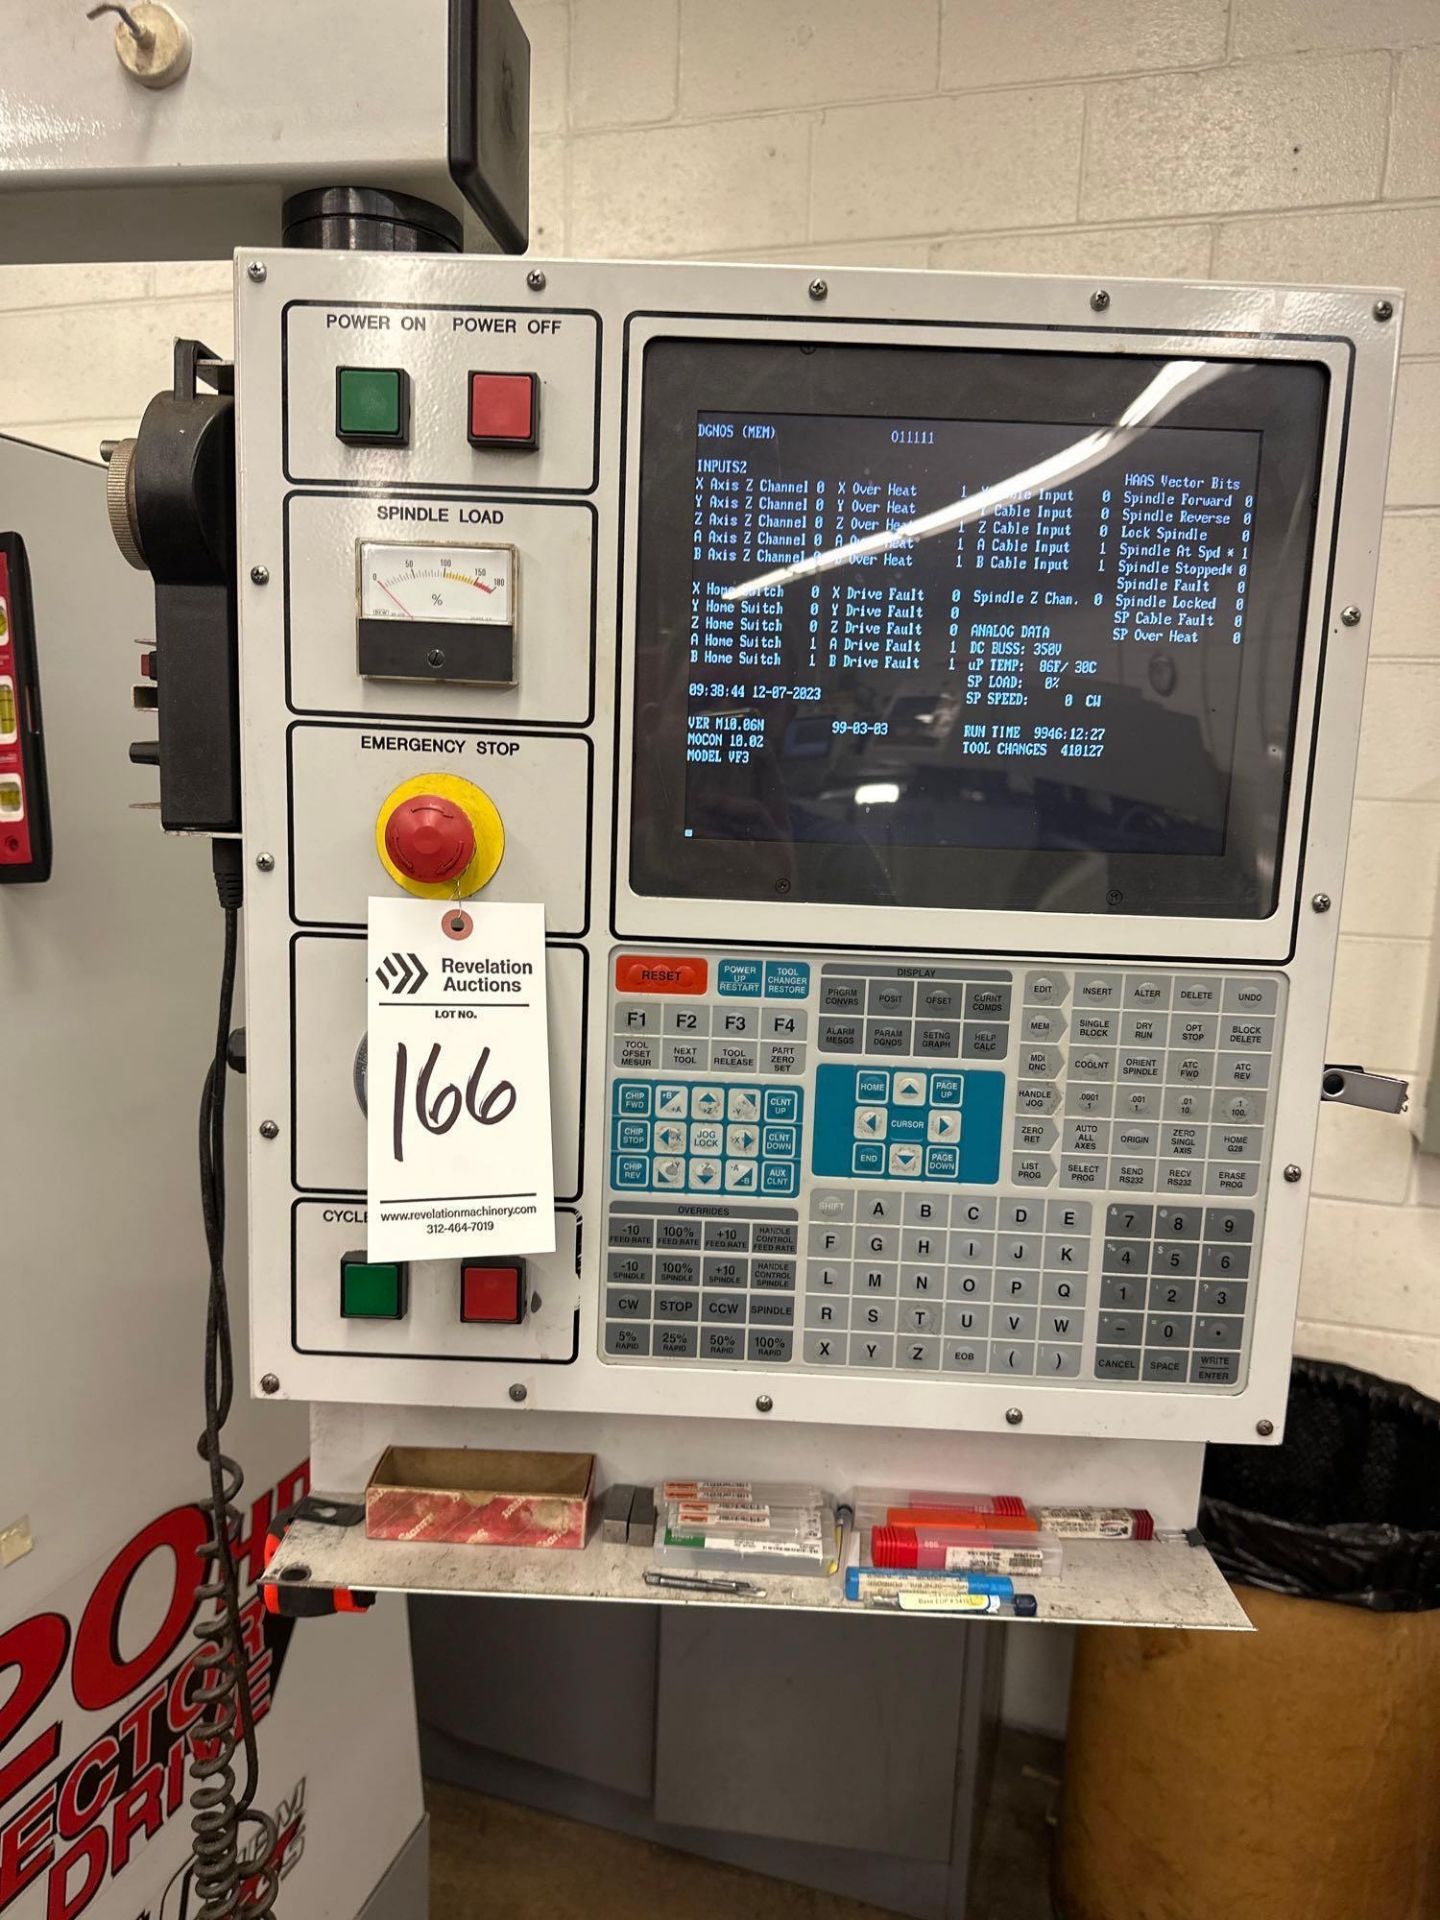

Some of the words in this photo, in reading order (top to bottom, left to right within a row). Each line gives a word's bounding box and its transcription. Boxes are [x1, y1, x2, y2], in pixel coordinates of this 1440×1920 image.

[326, 314, 390, 329] POWER
[401, 317, 426, 331] ON
[453, 318, 516, 333] POWER
[528, 320, 561, 334] OFF
[698, 424, 734, 437] DGNOS
[742, 425, 775, 439] (MEM)
[698, 459, 747, 473] INPUTS2
[696, 477, 704, 490] X
[711, 478, 739, 491] Axis
[746, 479, 753, 492] Z
[760, 480, 808, 493] Channel
[817, 481, 825, 493] 0
[1125, 474, 1154, 487] HAAS
[1161, 475, 1204, 488] Vector
[1212, 477, 1240, 490] Bits
[1124, 491, 1174, 506] Spindle
[1181, 494, 1232, 507] Forward
[1245, 496, 1253, 508] 0
[377, 506, 449, 522] SPINDLE
[459, 509, 504, 524] LOAD
[1122, 508, 1173, 524] Spindle
[1180, 511, 1230, 524] Reverse
[1243, 512, 1251, 524] 0
[1121, 526, 1150, 539] Lock
[1157, 527, 1208, 542] Spindle
[1242, 530, 1250, 542] 0
[405, 560, 413, 568] 50
[440, 559, 451, 567] 100
[475, 568, 486, 576] 150
[1117, 578, 1168, 593] Spindle
[1174, 580, 1210, 592] Fault
[1238, 581, 1245, 593] 0
[431, 594, 443, 606] %
[974, 590, 1024, 606] Spindle
[1030, 592, 1038, 604] Z
[1045, 592, 1078, 605] Chan.
[1094, 593, 1102, 606] 0
[1115, 595, 1166, 611] Spindle
[1172, 596, 1216, 610] Locked
[1236, 599, 1243, 611] 0
[971, 625, 1014, 638] ANALOG
[1021, 626, 1049, 638] DATA
[970, 641, 984, 654] DC
[991, 642, 1025, 655] BUSS:
[1033, 643, 1062, 656] 350V
[990, 659, 1024, 672] TEMP:
[1075, 661, 1097, 674] 30C
[968, 676, 982, 688] SP
[989, 676, 1022, 689] LOAD:
[1045, 677, 1060, 689] 0%
[753, 686, 821, 700] 12-07-2023
[966, 692, 981, 704] SP
[988, 692, 1028, 705] SPEED:
[1065, 694, 1073, 707] 0
[1085, 695, 1101, 707] CW
[688, 717, 709, 730] VER
[832, 722, 888, 735] 99-03-03
[964, 725, 985, 738] RUN
[992, 726, 1020, 738] TIME
[361, 735, 466, 753] EMERGENCY
[476, 741, 520, 756] STOP
[688, 733, 722, 747] MOCON
[730, 734, 764, 748] 10.02
[963, 742, 990, 754] TOOL
[997, 742, 1047, 756] CHANGES
[687, 749, 721, 763] MODEL
[729, 750, 749, 763] VF3
[442, 958, 533, 975] Revelation
[777, 968, 799, 976] TOOL
[642, 970, 681, 981] RESET
[897, 968, 935, 977] DISPLAY
[443, 977, 522, 992] Auctions
[768, 977, 807, 985] CHANGER
[720, 984, 759, 992] RESTART
[768, 986, 806, 994] RESTORE
[1034, 985, 1052, 993] EDIT
[1082, 987, 1112, 996] INSERT
[1134, 989, 1161, 997] ALTER
[1180, 990, 1213, 999] DELETE
[1238, 993, 1262, 1002] UNDO
[435, 1010, 455, 1018] LOT
[458, 1010, 477, 1019] NO.
[628, 1013, 646, 1026] F1
[676, 1015, 697, 1028] F2
[725, 1016, 746, 1030] F3
[774, 1019, 795, 1032] F4
[1031, 1022, 1050, 1030] MEM
[1079, 1019, 1109, 1029] SINGLE
[1136, 1022, 1153, 1030] DRY
[1079, 1027, 1108, 1037] BLOCK
[1185, 1024, 1202, 1032] OPT
[1232, 1026, 1261, 1035] BLOCK
[1135, 1030, 1153, 1039] RUN
[1182, 1032, 1204, 1041] STOP
[1230, 1034, 1262, 1043] DELETE
[625, 1041, 648, 1049] TOOL
[674, 1047, 697, 1055] NEXT
[723, 1049, 746, 1057] TOOL
[772, 1047, 794, 1055] PART
[621, 1059, 651, 1067] MESUR
[674, 1056, 696, 1064] TOOL
[714, 1058, 753, 1066] RELEASE
[771, 1056, 794, 1064] ZERO
[861, 1083, 884, 1091] HOME
[936, 1081, 957, 1090] PAGE
[941, 1090, 952, 1098] UP
[394, 1042, 517, 1162] 166
[891, 1120, 924, 1129] CURSOR
[697, 1131, 715, 1139] JOG
[694, 1139, 718, 1147] LOCK
[860, 1154, 878, 1162] END
[932, 1153, 953, 1162] PAGE
[930, 1162, 955, 1170] DOWN
[380, 1205, 536, 1223] www.revelationmachinery.com
[678, 1206, 729, 1216] OVERRIDES
[873, 1202, 884, 1216] A
[920, 1205, 931, 1218] B
[968, 1207, 979, 1220] C
[1016, 1210, 1027, 1222] D
[1064, 1212, 1075, 1225] E
[1125, 1215, 1134, 1228] 7
[426, 1221, 494, 1234] 312-464-7019
[1174, 1218, 1183, 1230] 8
[1224, 1220, 1234, 1233] 9
[618, 1300, 639, 1310] CW
[660, 1301, 693, 1312] STOP
[709, 1303, 738, 1314] CCW
[751, 1305, 792, 1315] SPINDLE
[1098, 1359, 1135, 1368] CANCEL
[1150, 1362, 1179, 1370] SPACE
